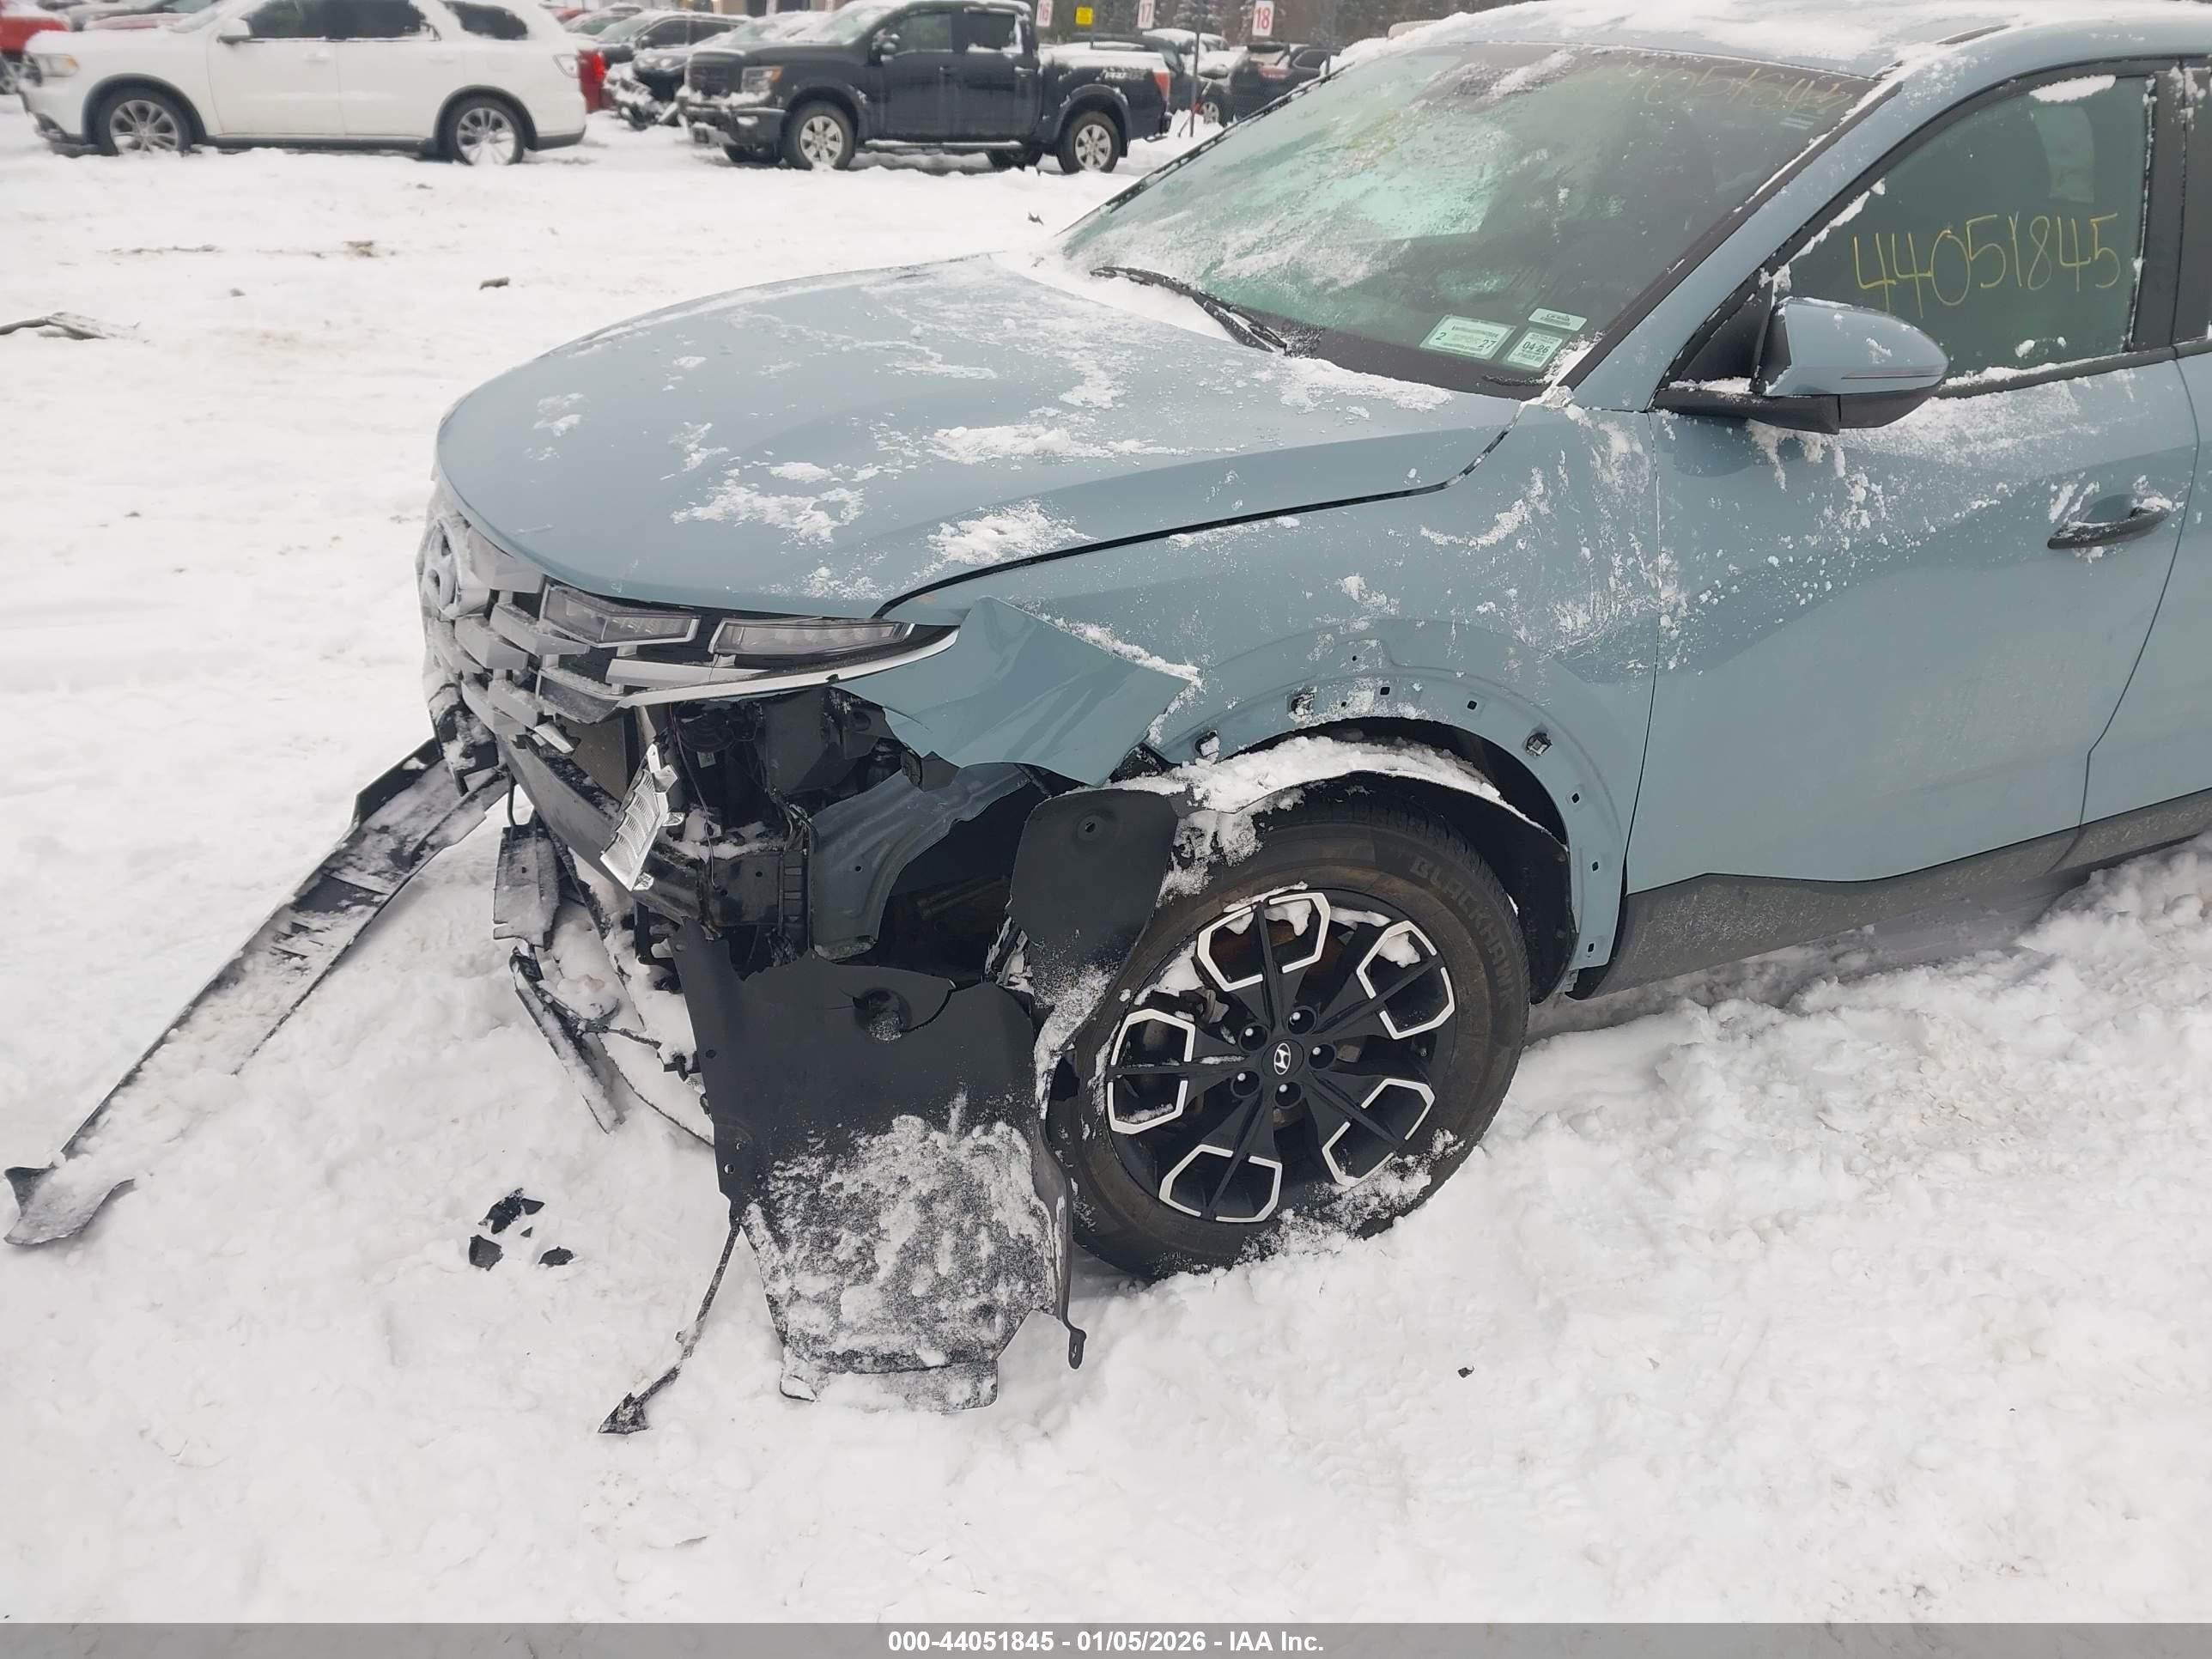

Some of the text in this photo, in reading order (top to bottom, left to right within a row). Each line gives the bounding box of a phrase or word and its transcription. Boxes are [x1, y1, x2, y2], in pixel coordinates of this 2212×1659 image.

[1140, 3, 1152, 23] 17
[1255, 7, 1271, 29] 18
[1853, 211, 2122, 319] 44051845
[1435, 331, 1448, 341] 2
[1478, 339, 1497, 349] 27
